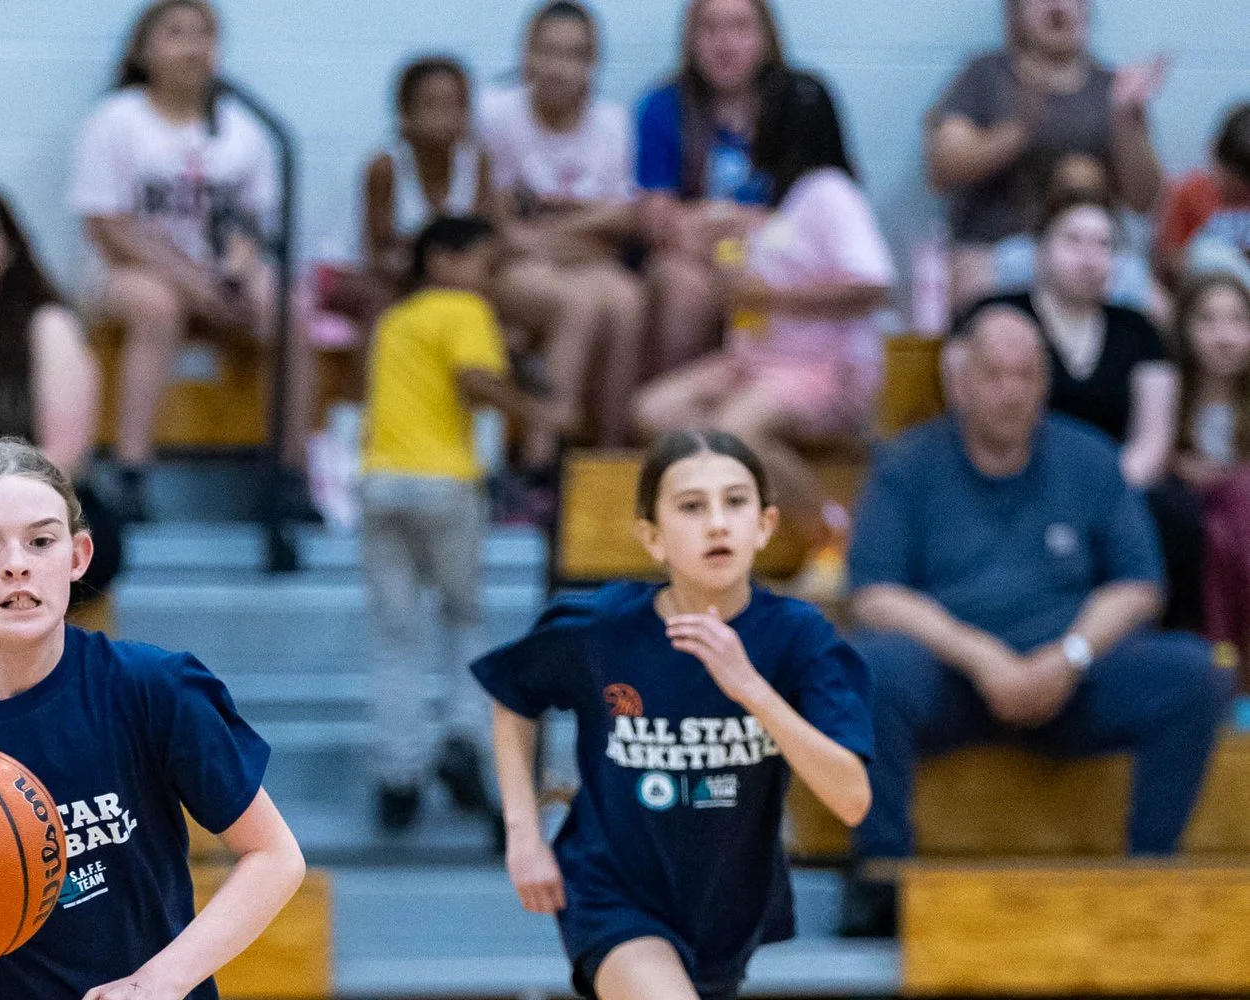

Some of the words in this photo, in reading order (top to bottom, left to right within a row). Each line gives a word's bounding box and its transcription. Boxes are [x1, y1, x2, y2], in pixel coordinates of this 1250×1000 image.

[614, 715, 676, 744] ALL
[679, 715, 765, 744] STAR
[56, 793, 122, 831] TAR
[65, 809, 137, 858] BALL
[12, 775, 62, 926] Wilson
[69, 860, 107, 882] S.A.F.E.
[76, 872, 106, 892] TEAM
